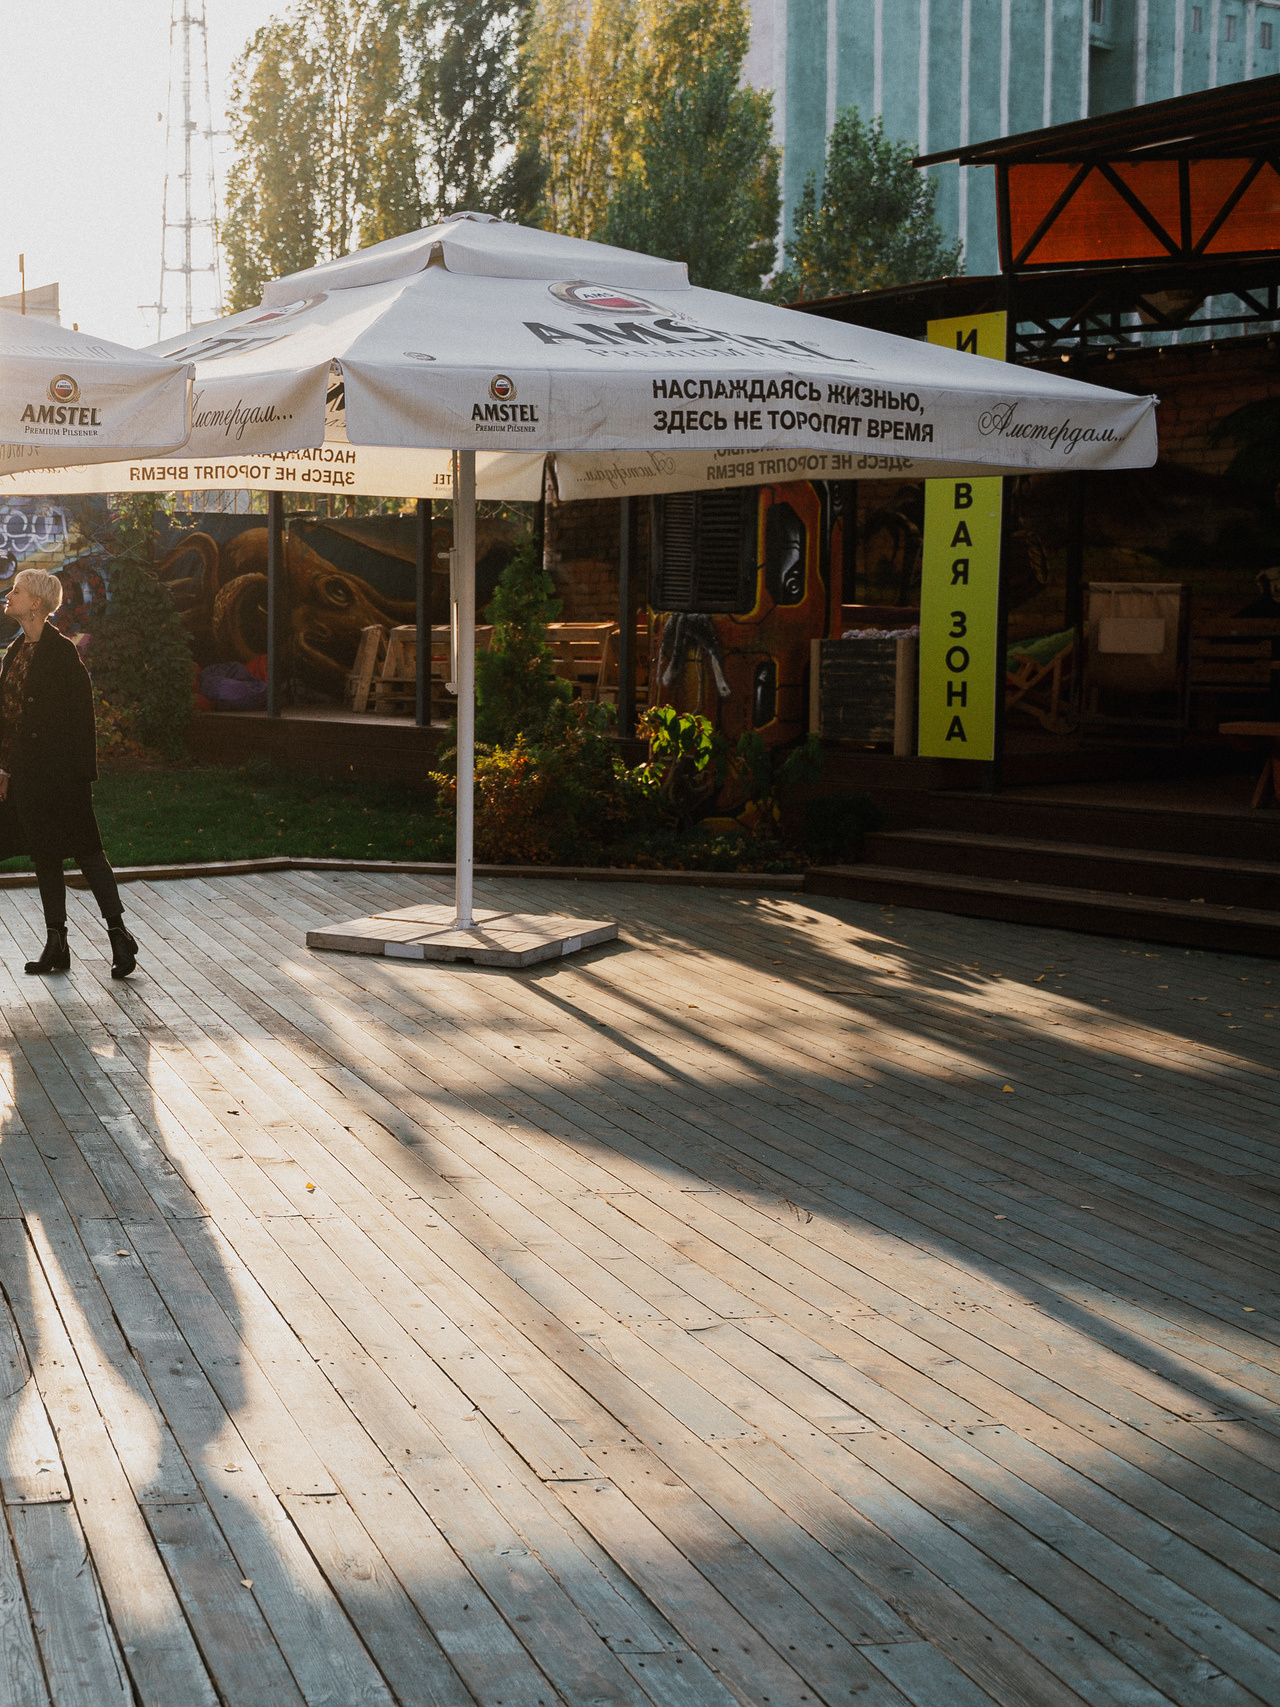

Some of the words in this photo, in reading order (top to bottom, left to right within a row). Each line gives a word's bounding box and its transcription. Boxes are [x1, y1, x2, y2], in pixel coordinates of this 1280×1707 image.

[653, 379, 821, 402] НАСЛАЖДАЯСЬ
[827, 384, 925, 415] ЖИЗНЬЮ,
[20, 404, 101, 427] AMSTEL
[471, 404, 538, 422] AMSTEL
[24, 426, 61, 436] PREMIUM
[63, 428, 98, 437] PILSENER
[475, 423, 506, 432] PREMIUM
[508, 424, 536, 433] PILSENER
[653, 410, 728, 433] ЗДЕСЬ
[734, 411, 763, 431] НЕ
[767, 410, 862, 438] ТОРОПЯТ
[866, 419, 934, 443] ВРЕМЯ
[945, 610, 970, 743] ЗОНА
